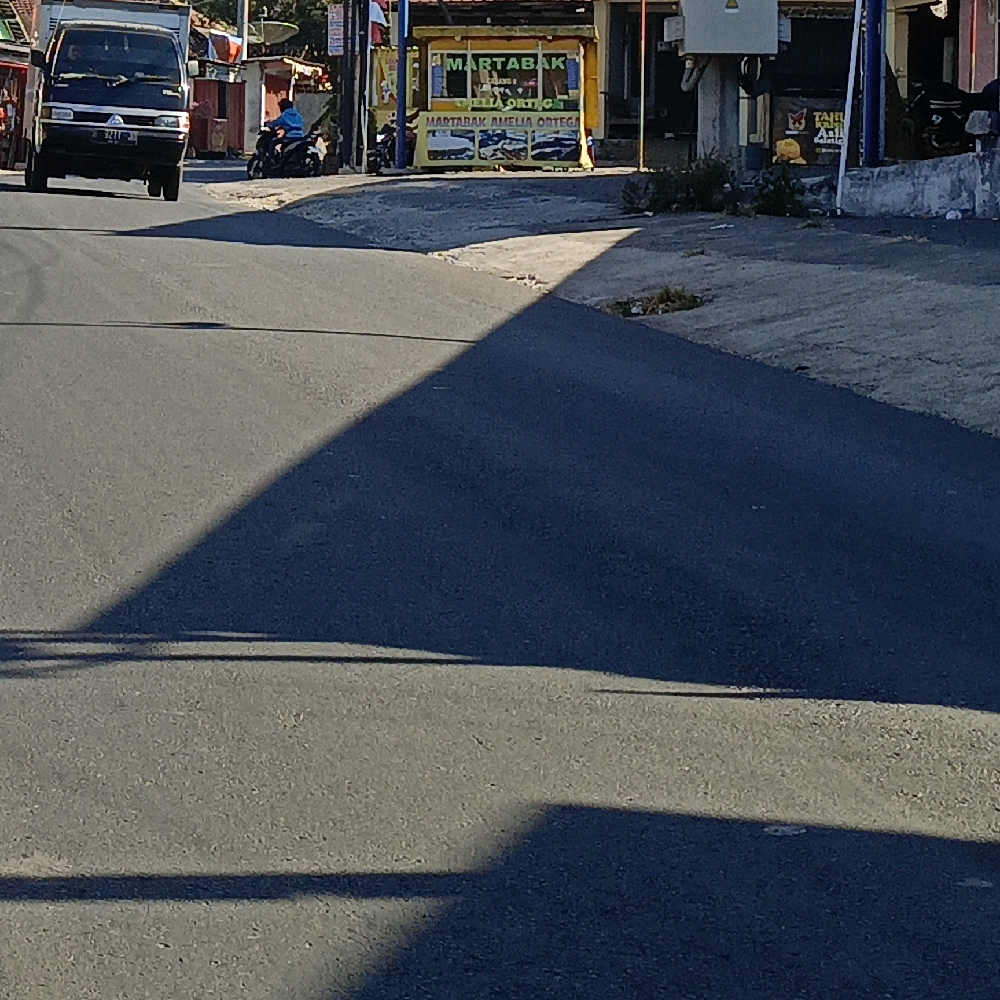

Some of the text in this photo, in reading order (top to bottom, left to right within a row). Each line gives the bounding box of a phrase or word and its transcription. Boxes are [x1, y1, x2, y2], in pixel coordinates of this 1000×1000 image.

[446, 57, 566, 71] MARTABAK
[426, 116, 487, 128] MARTABAK
[490, 116, 533, 128] AMELIA
